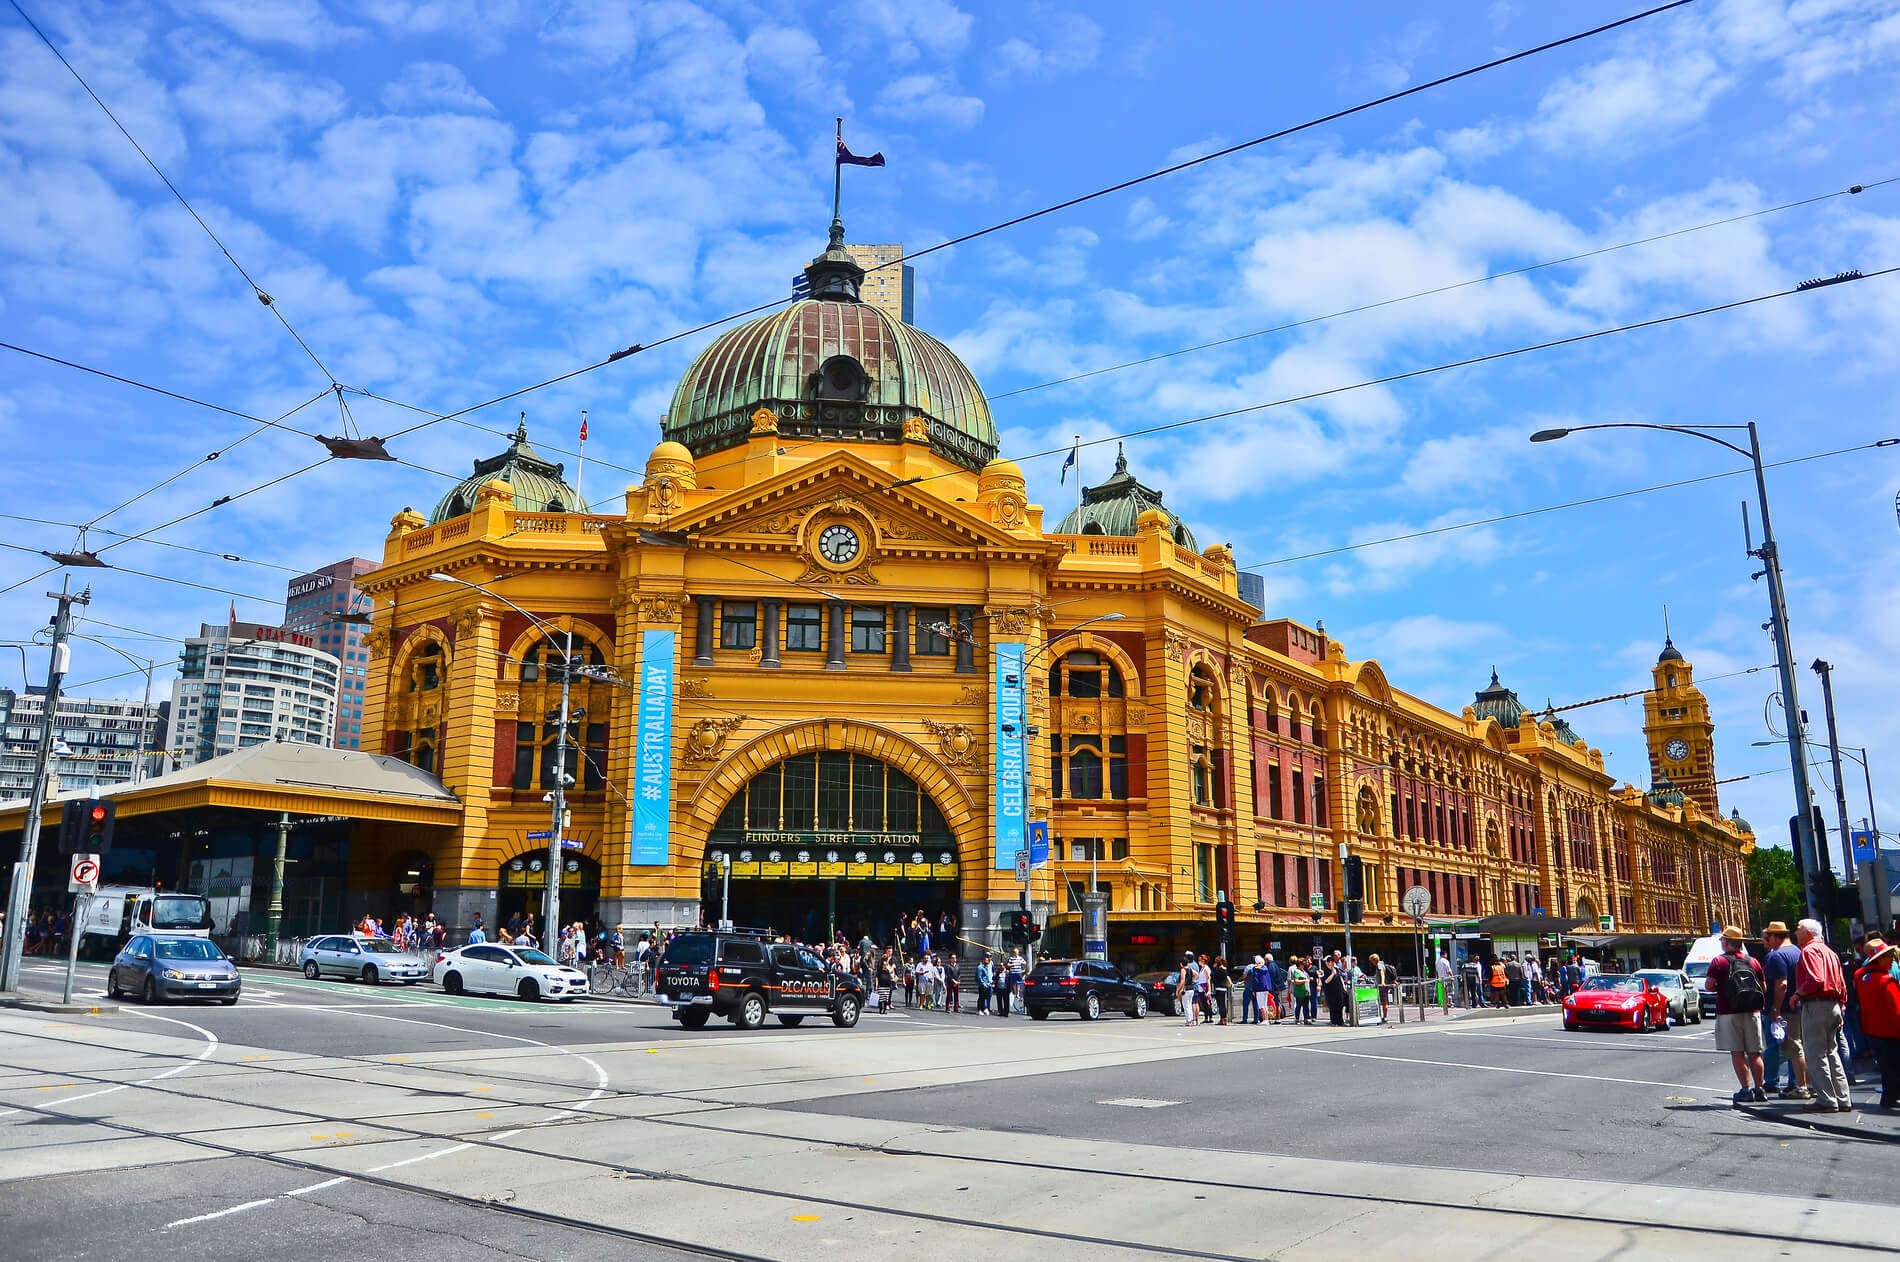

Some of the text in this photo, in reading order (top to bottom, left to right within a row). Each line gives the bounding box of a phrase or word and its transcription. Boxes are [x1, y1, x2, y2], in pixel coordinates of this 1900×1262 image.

[317, 575, 334, 588] SUN
[256, 627, 286, 641] QUAY
[1002, 686, 1021, 727] YOUR
[642, 665, 668, 801] #AUSTRALIADAY
[745, 832, 920, 844] FLINDERS STREET STATION
[667, 976, 700, 986] TOYOTA
